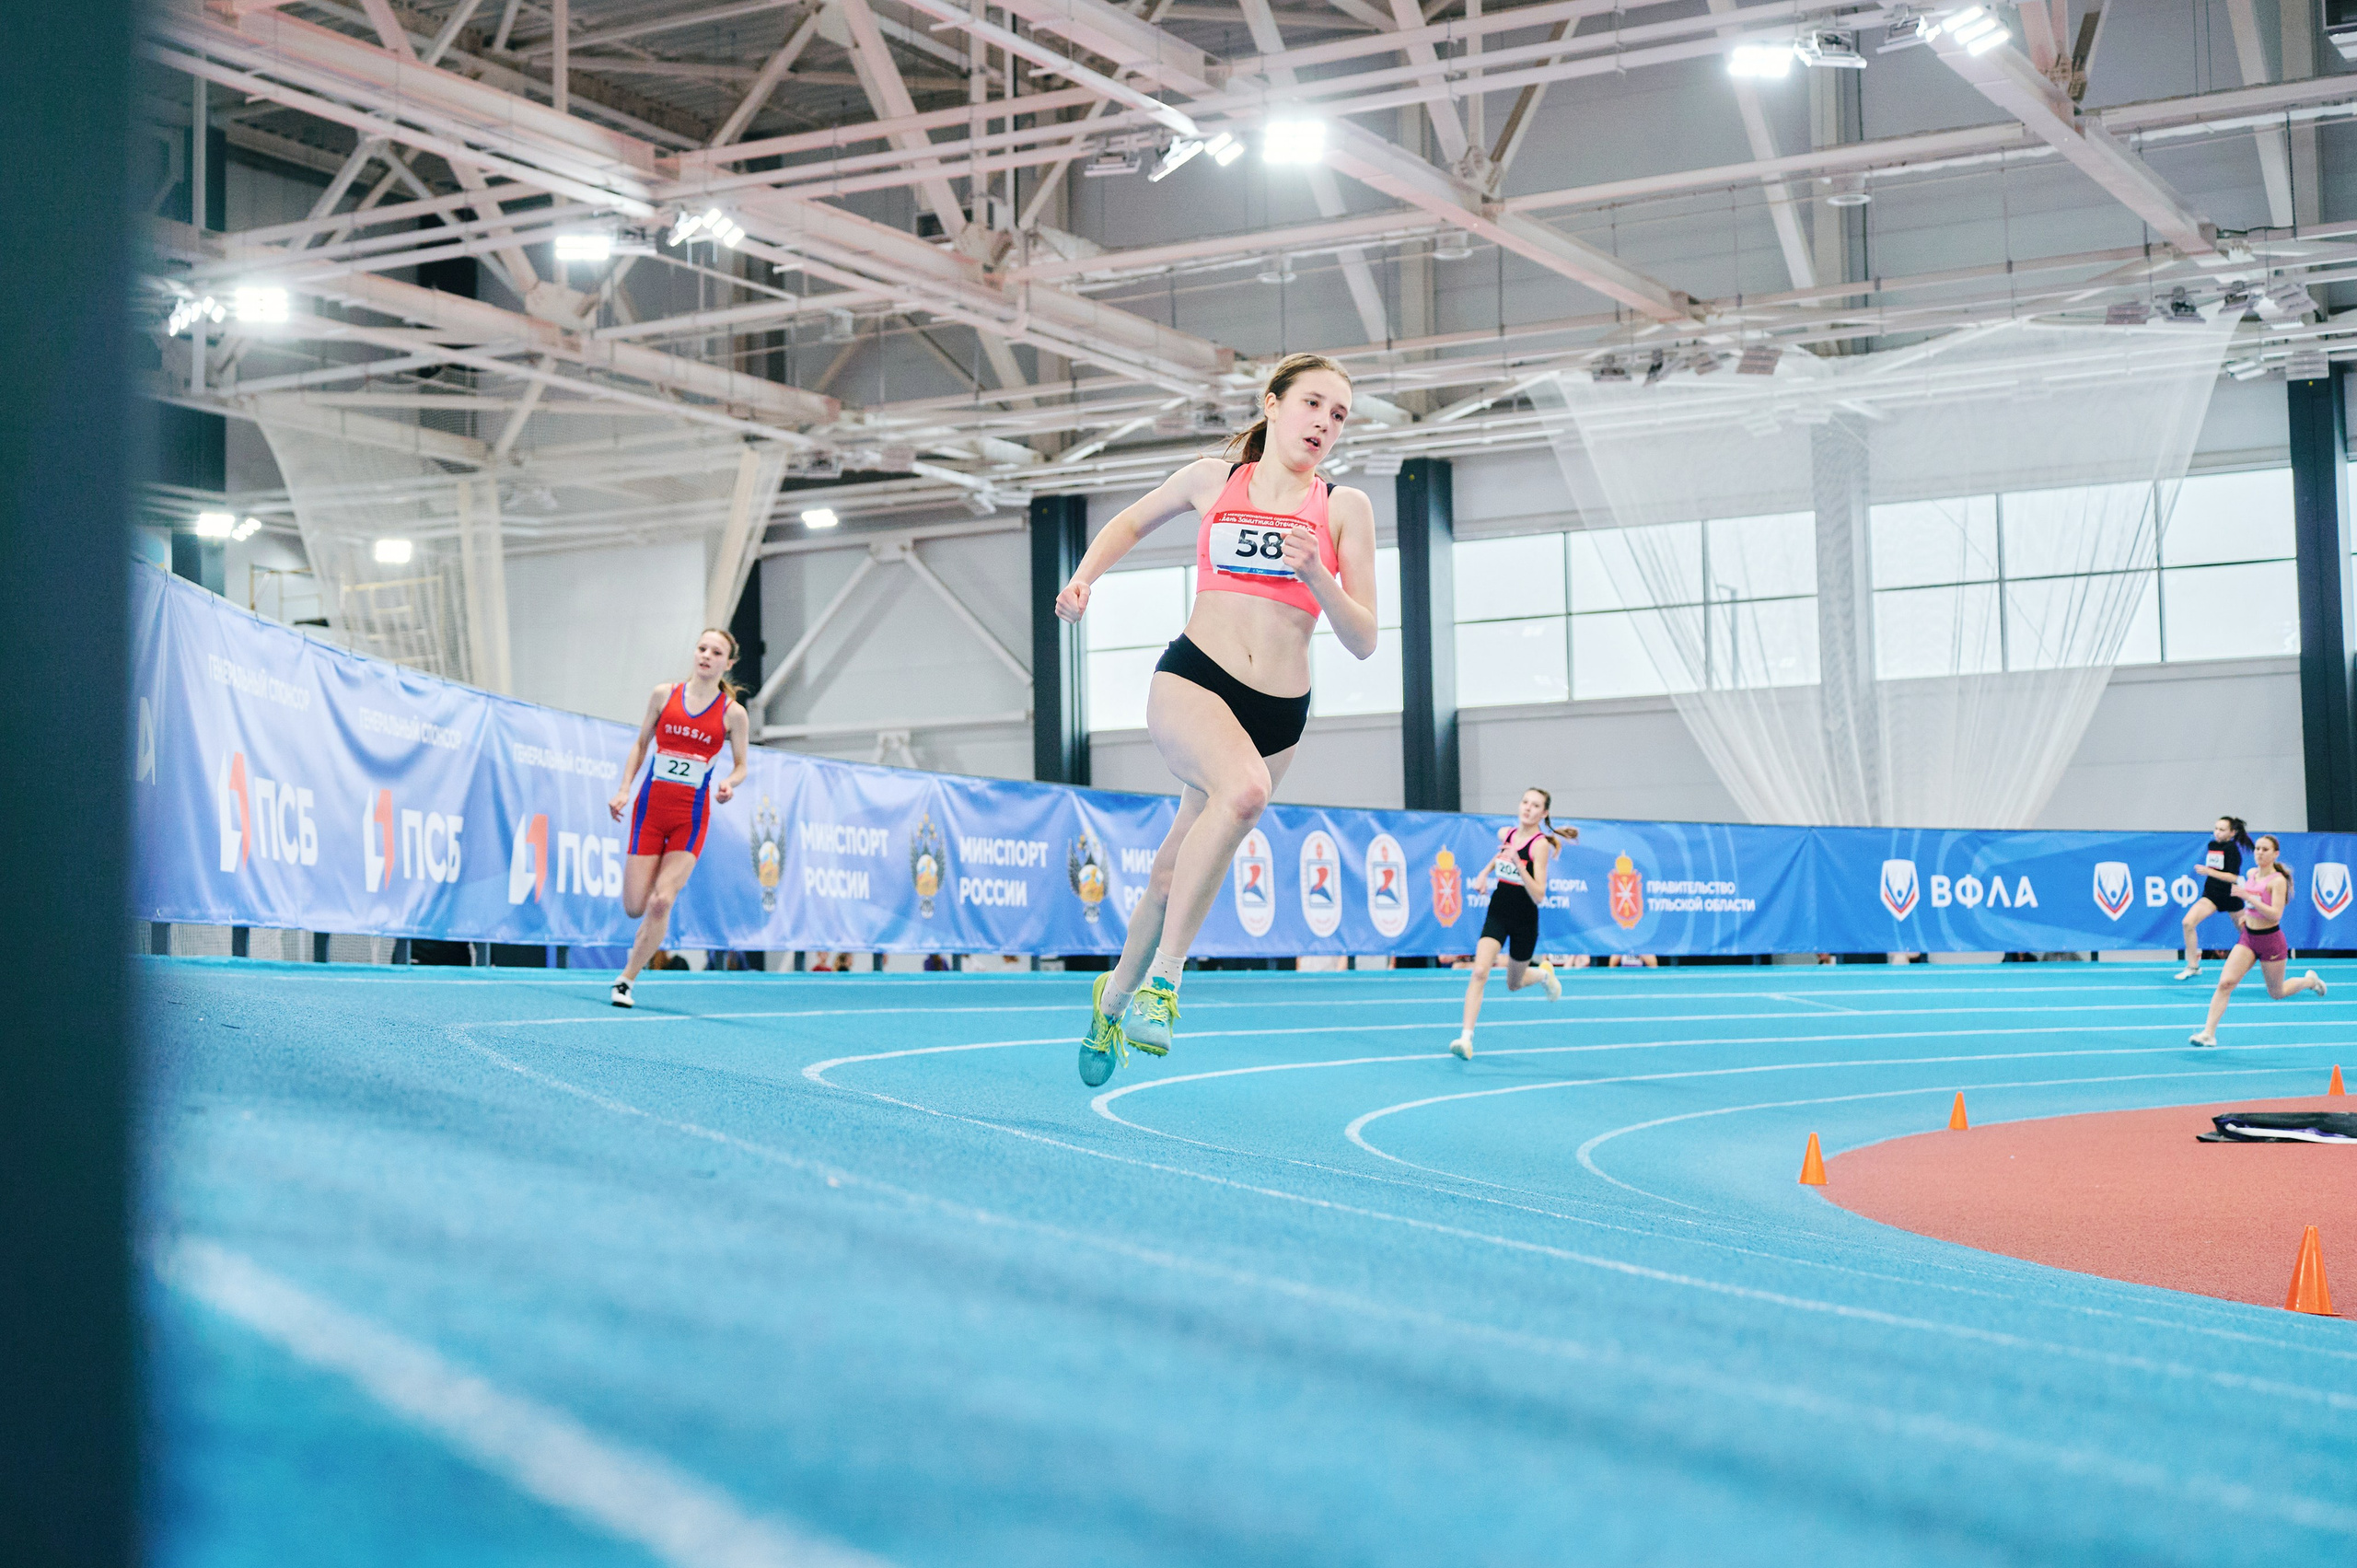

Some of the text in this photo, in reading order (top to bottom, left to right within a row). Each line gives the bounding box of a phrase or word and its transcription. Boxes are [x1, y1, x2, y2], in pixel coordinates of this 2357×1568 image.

[1238, 517, 1273, 526] Защитника
[1236, 528, 1283, 560] 58
[208, 654, 311, 712] ГЕНЕРАЛЬНЫЙ СПОНСОР
[359, 706, 462, 749] ГЕНЕРАЛЬНЫЙ СПОНСОР
[665, 724, 713, 745] RUSSIA
[513, 742, 619, 780] ГЕНЕРАЛЬНЫЙ СПОНСОР
[668, 760, 691, 777] 22
[254, 776, 319, 866] ПСБ
[401, 807, 464, 884] ПСБ
[800, 820, 889, 857] МИНСПОРТ
[959, 835, 1049, 867] МИНСПОРТ
[556, 830, 624, 898] ПСБ
[804, 865, 870, 900] РОССИИ
[959, 877, 1028, 907] РОССИИ
[1549, 878, 1588, 893] СПОРТА
[1646, 880, 1736, 895] ПРАВИТЕЛЬСТВО
[1930, 874, 2038, 909] ВФЛА
[2144, 874, 2200, 909] ВФ
[1538, 896, 1571, 909] АСТИ
[1647, 896, 1757, 912] ТУЛЬСКОЙ ОБЛАСТИ
